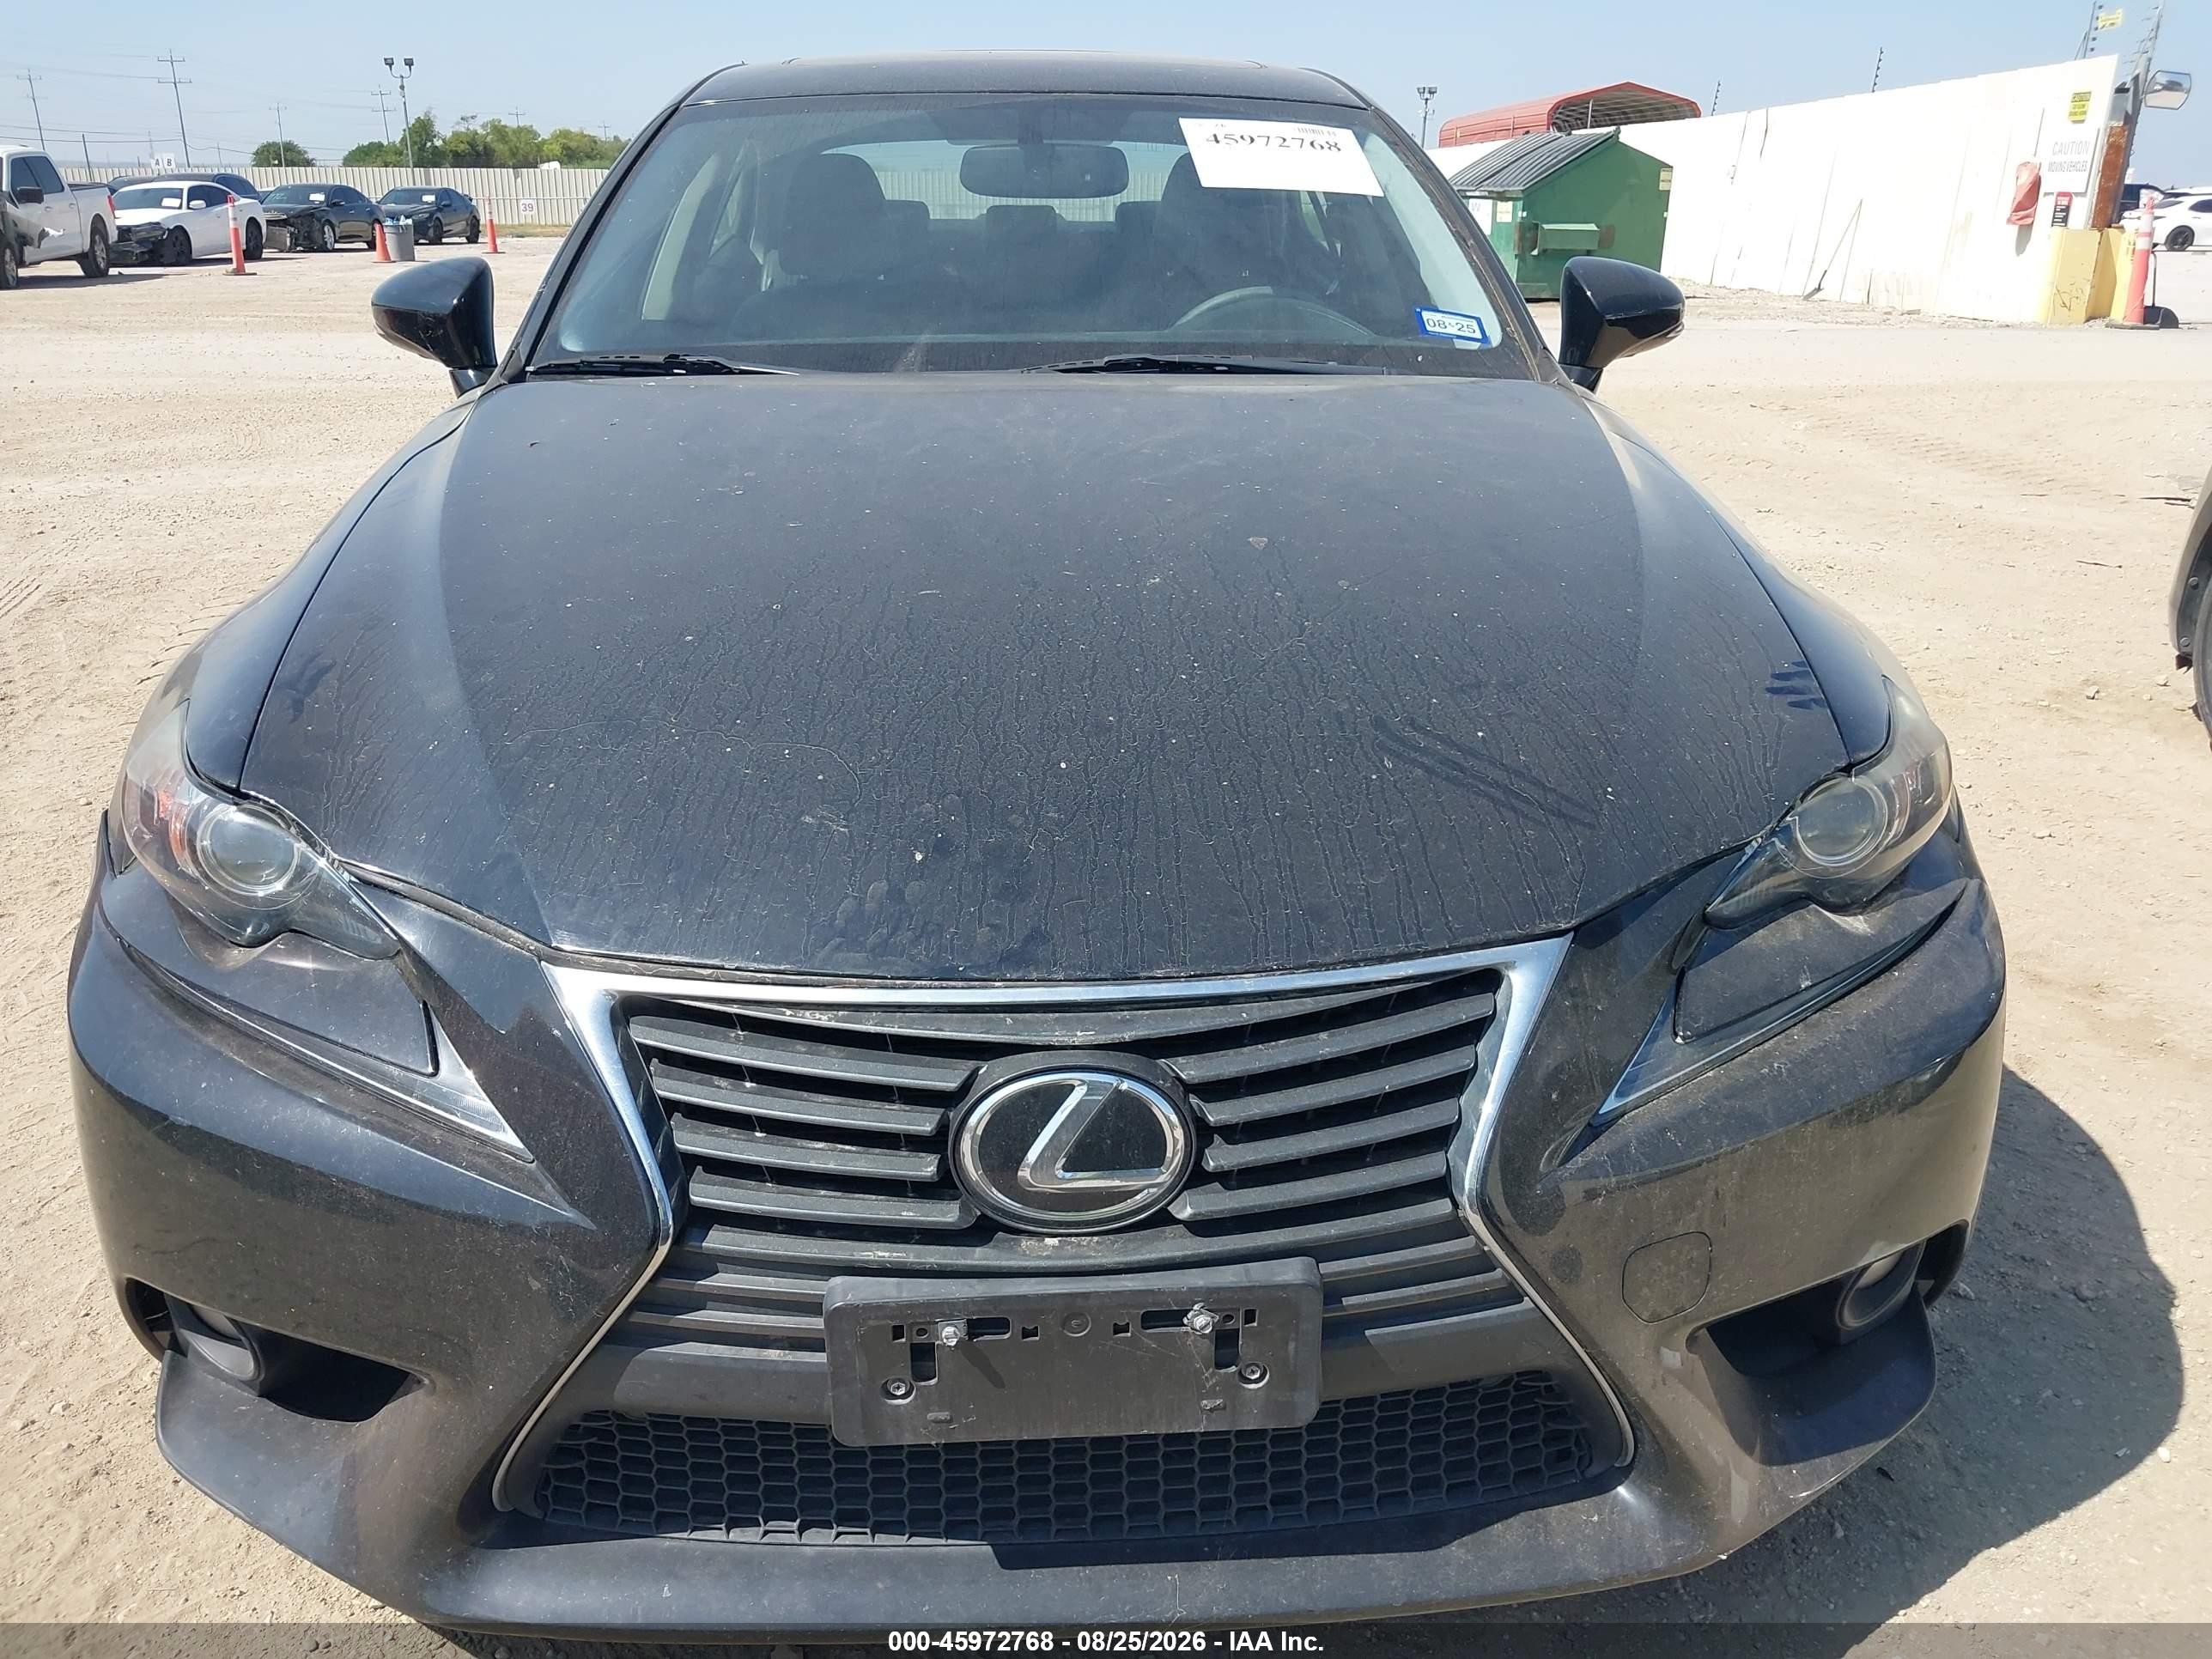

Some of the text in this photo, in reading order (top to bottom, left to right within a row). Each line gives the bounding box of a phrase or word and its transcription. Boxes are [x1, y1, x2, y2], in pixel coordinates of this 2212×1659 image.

[1206, 133, 1341, 152] 45972768
[2052, 141, 2089, 155] CAUTION
[155, 158, 160, 167] A
[167, 158, 172, 167] B
[521, 203, 534, 212] 39
[1426, 318, 1448, 330] 08
[1455, 322, 1476, 334] 25
